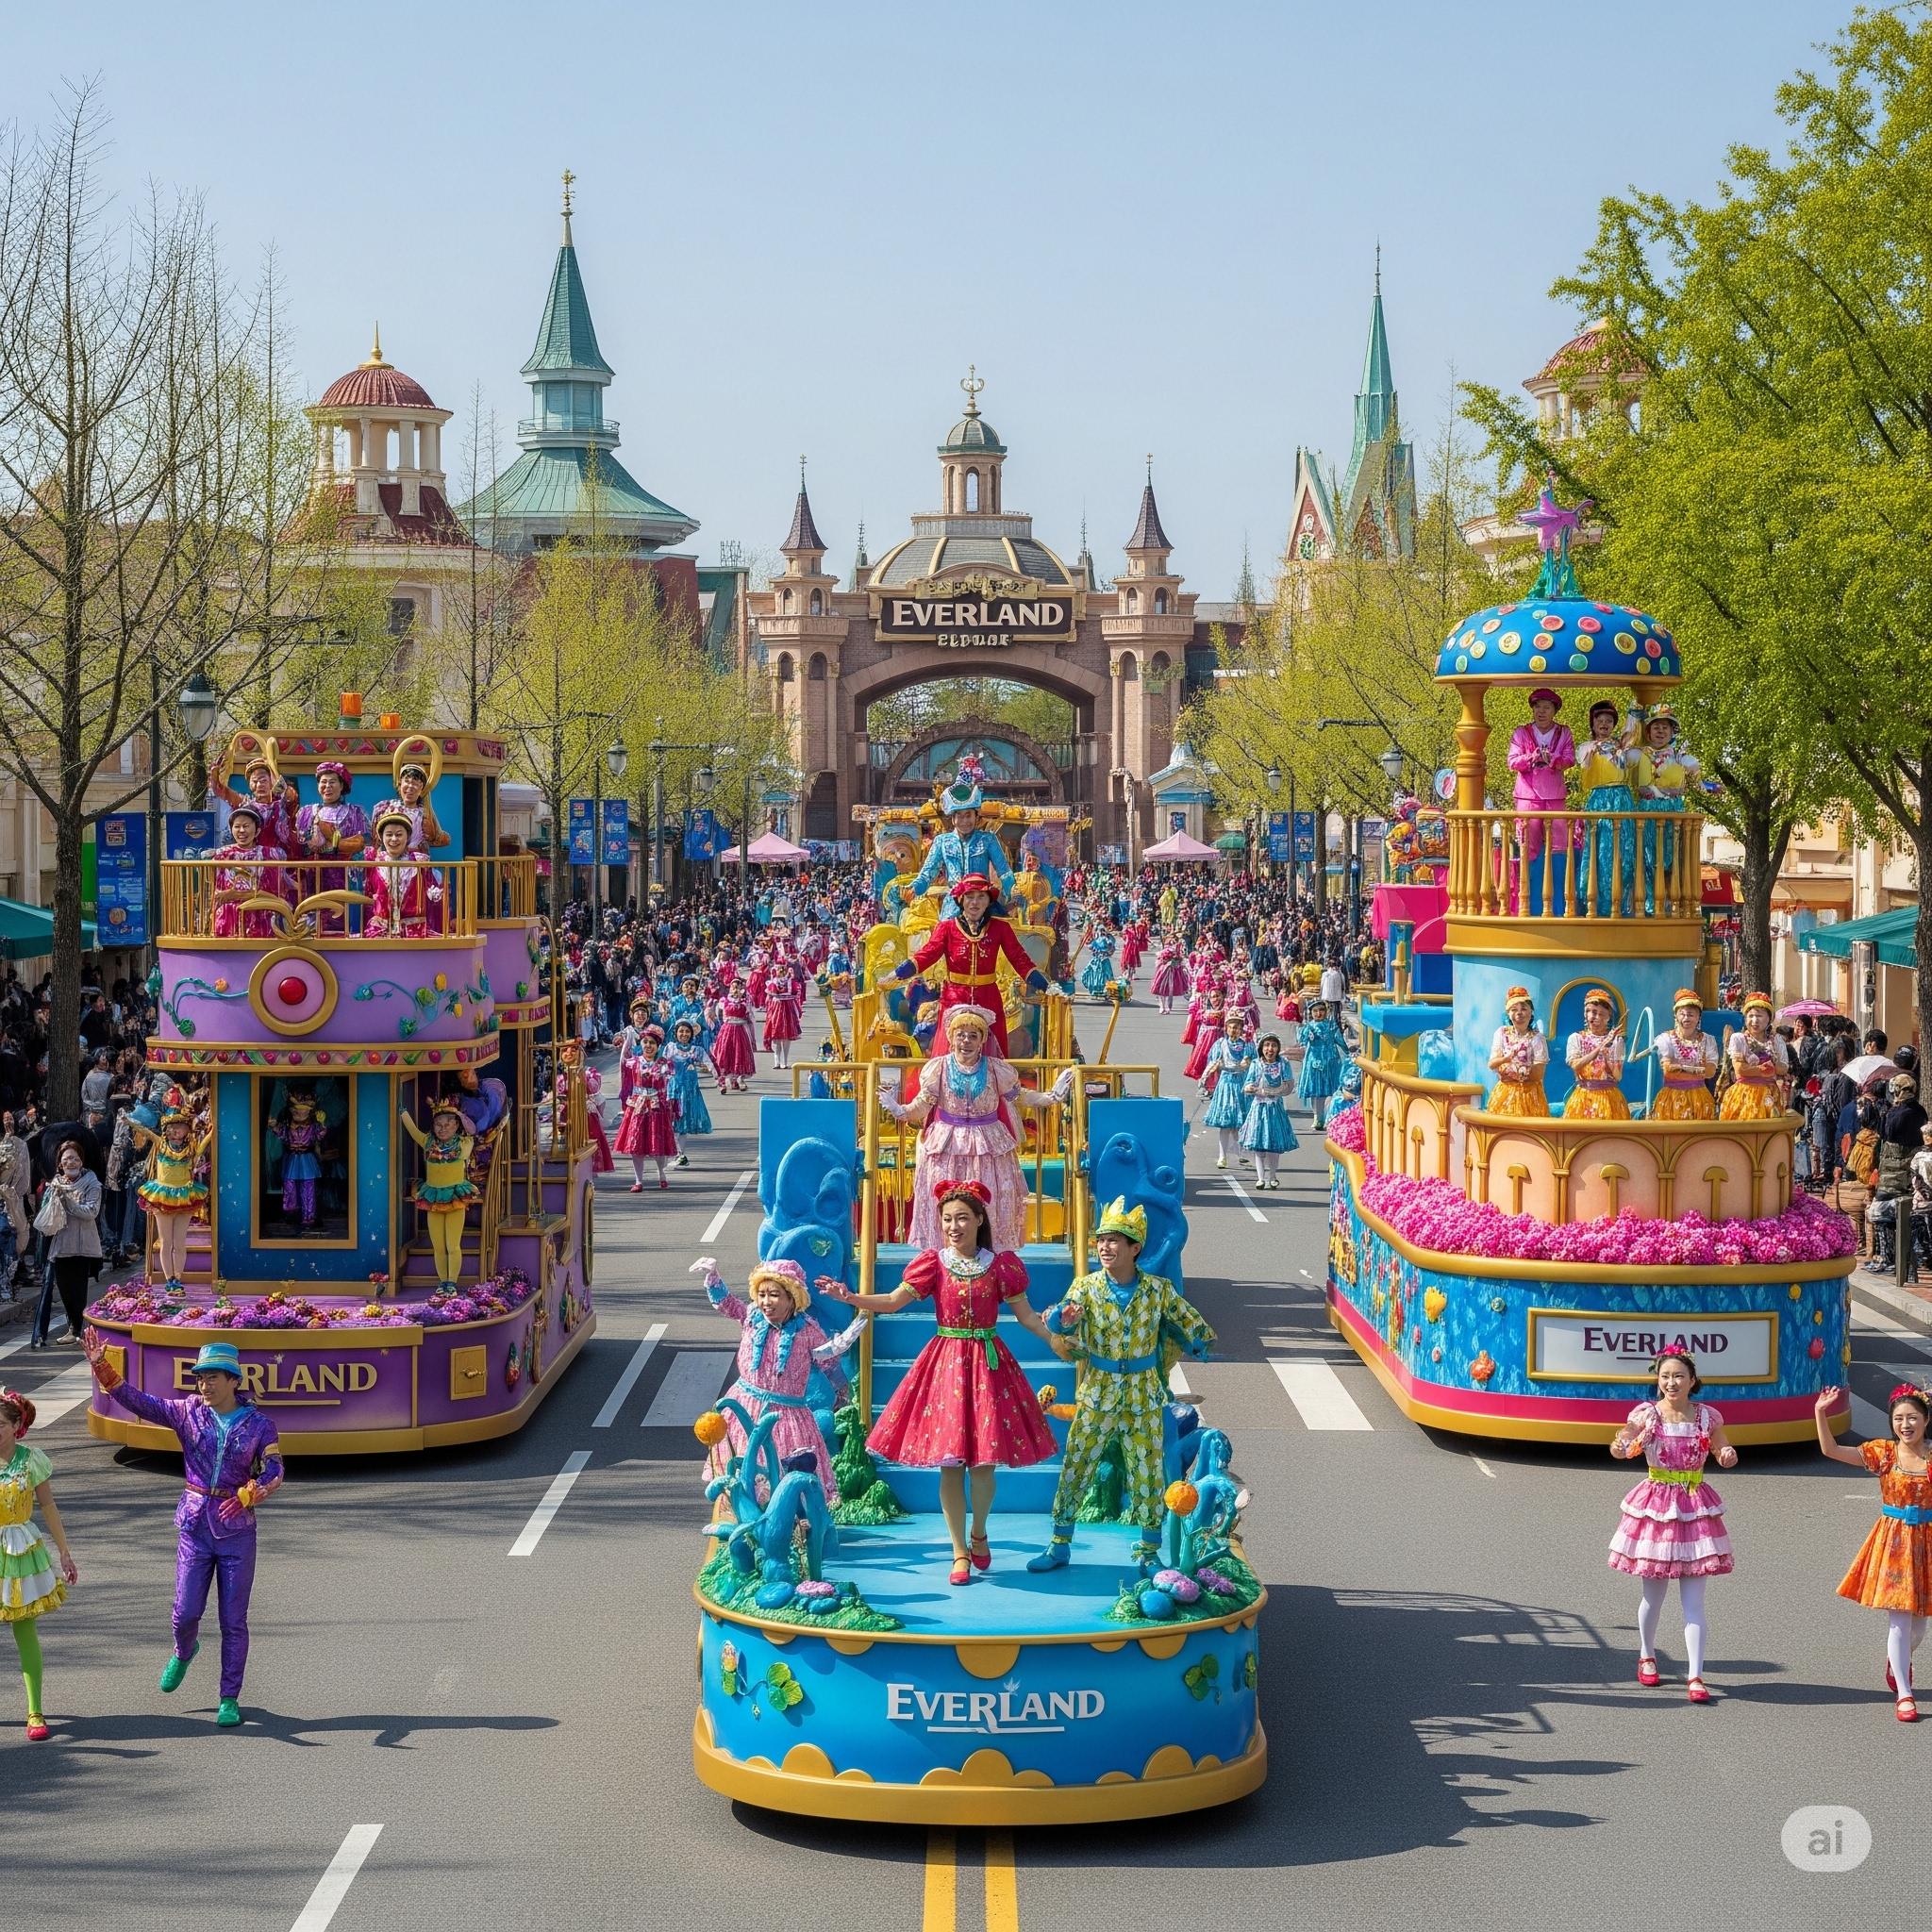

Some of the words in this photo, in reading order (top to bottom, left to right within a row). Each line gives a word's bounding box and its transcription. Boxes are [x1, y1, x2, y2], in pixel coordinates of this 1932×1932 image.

[891, 600, 1064, 627] EVERLAND
[173, 1357, 378, 1398] ERLAND
[886, 1683, 1106, 1734] EVERLAND
